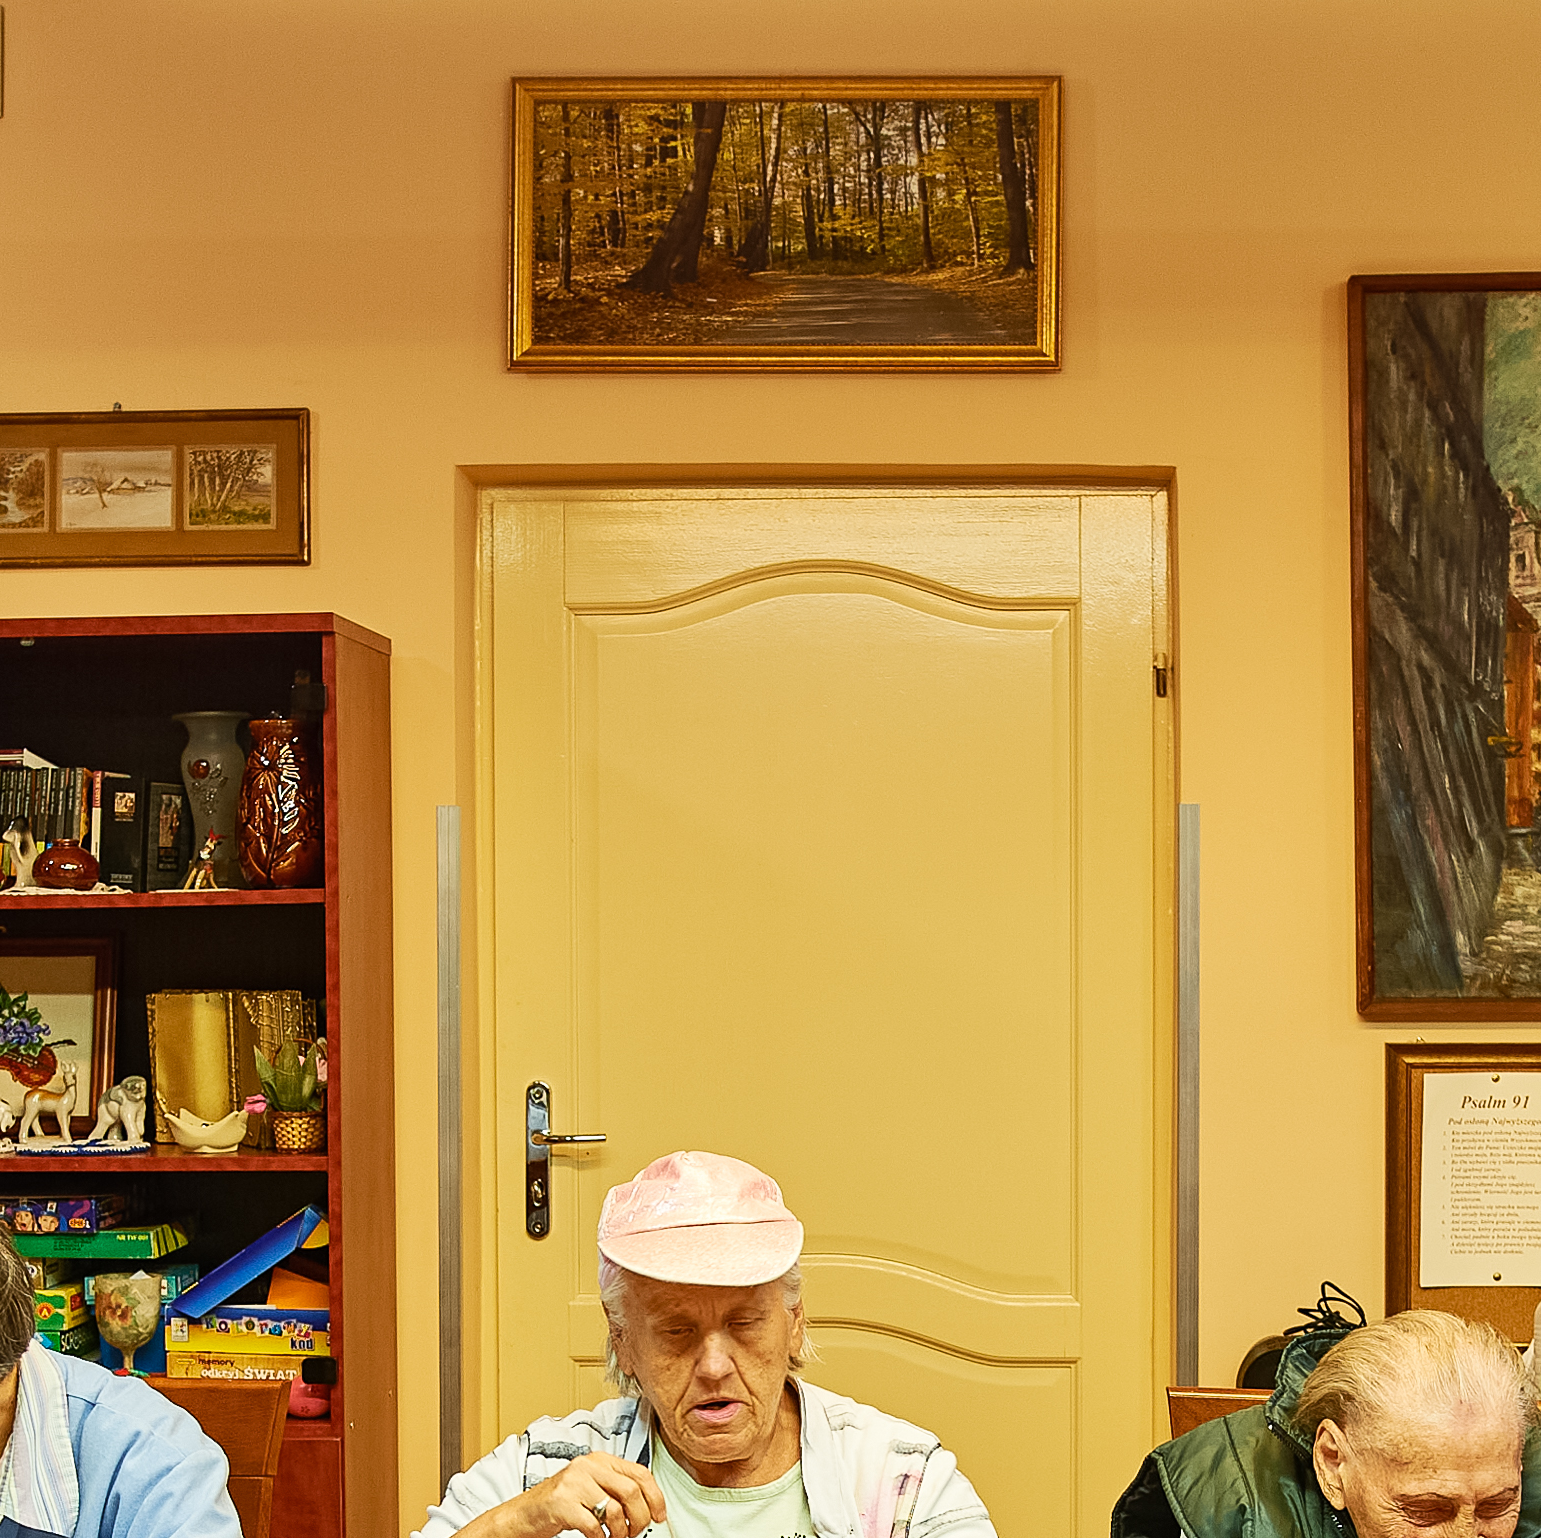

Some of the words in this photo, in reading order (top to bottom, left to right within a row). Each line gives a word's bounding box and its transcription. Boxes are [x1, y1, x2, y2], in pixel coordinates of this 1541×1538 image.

[1461, 1095, 1506, 1109] Psalm
[1512, 1095, 1530, 1109] 91
[197, 1355, 235, 1367] memory
[201, 1367, 240, 1381] odkryj
[243, 1366, 297, 1381] ŚWIAT
